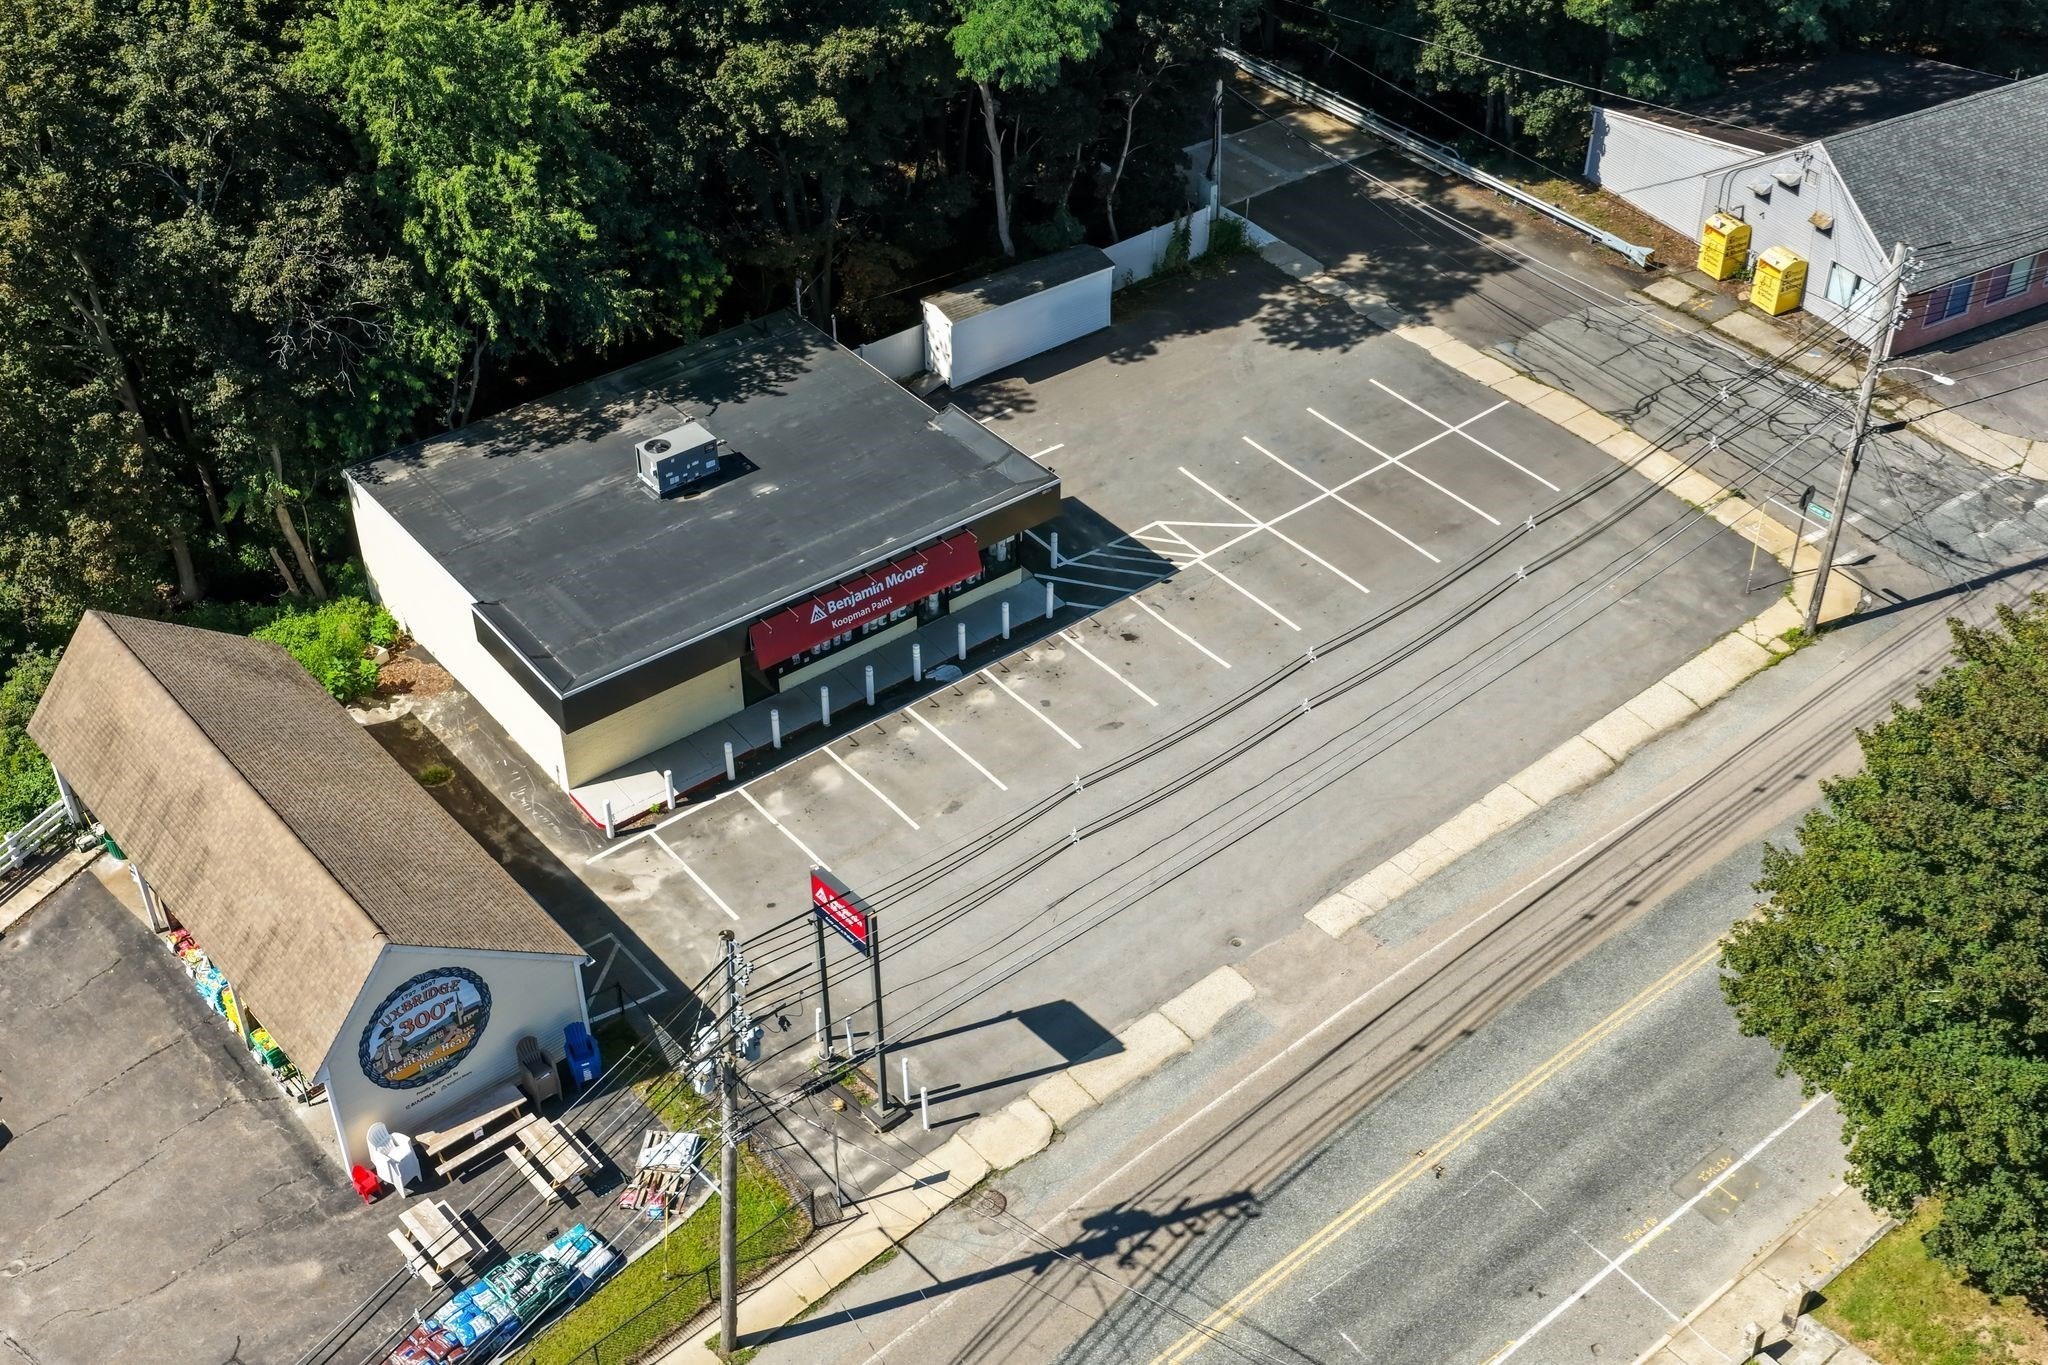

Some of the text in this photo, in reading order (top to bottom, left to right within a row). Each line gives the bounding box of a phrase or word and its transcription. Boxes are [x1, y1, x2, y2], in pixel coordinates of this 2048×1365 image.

[827, 563, 925, 614] Benjamin Moore
[831, 596, 893, 629] Koopman Paint
[379, 979, 461, 1028] UXBRIDGE
